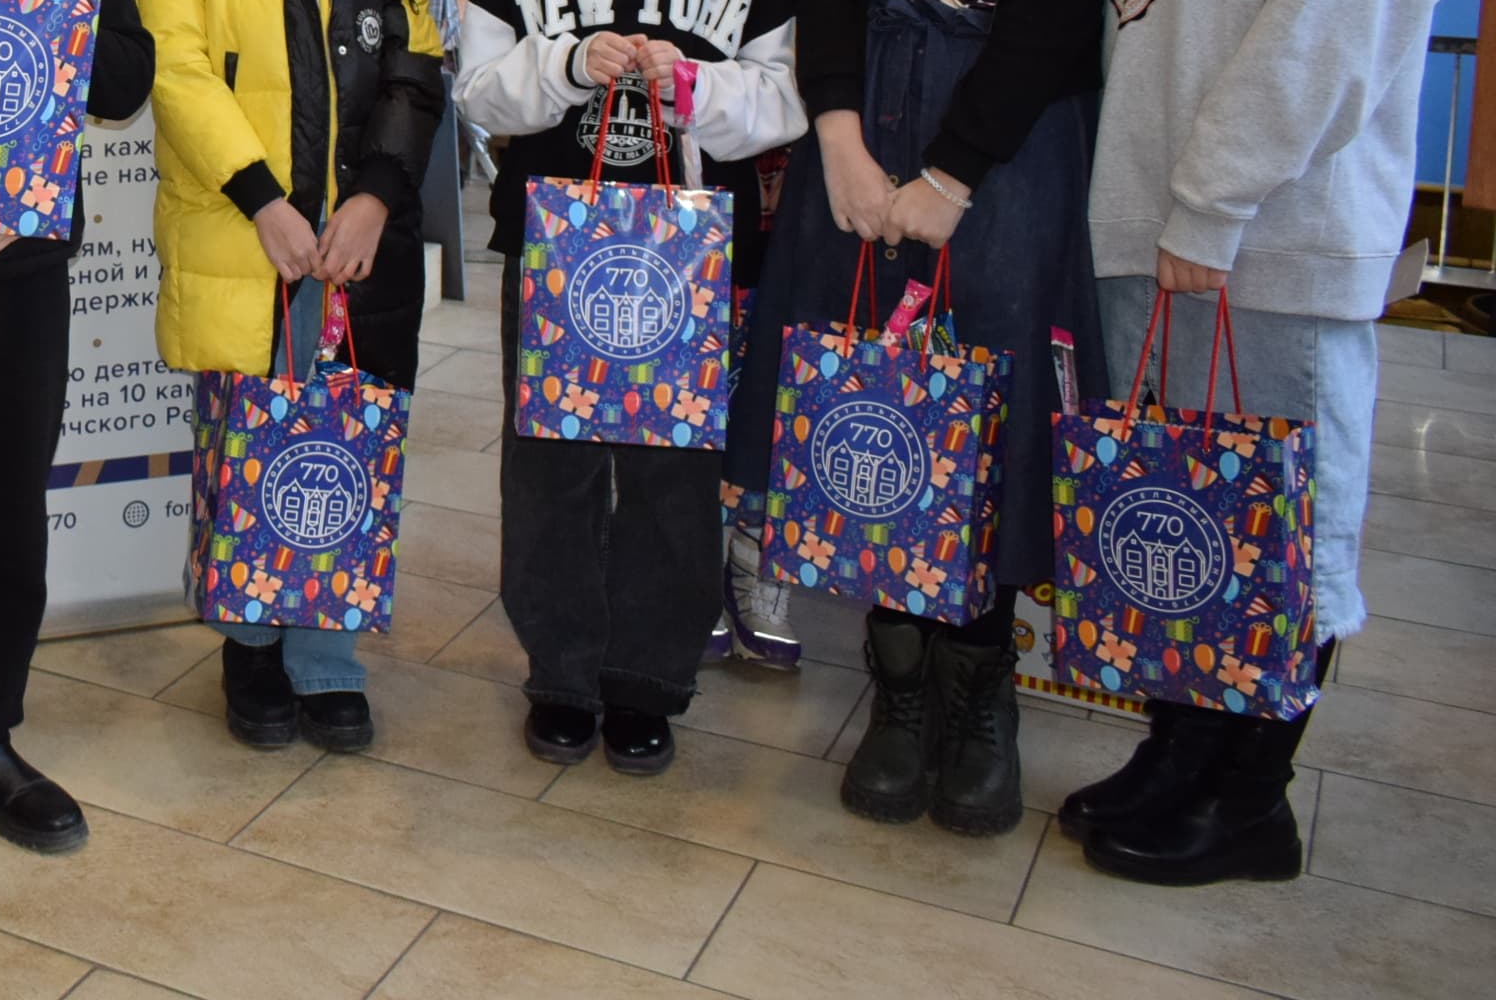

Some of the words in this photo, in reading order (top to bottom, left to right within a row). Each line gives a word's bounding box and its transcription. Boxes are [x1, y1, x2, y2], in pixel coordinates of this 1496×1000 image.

[606, 267, 648, 288] 770
[72, 291, 159, 315] держк
[95, 359, 173, 383] деяте
[81, 391, 110, 408] на
[120, 383, 146, 404] 10
[850, 422, 893, 448] 770
[300, 462, 339, 482] 770
[47, 511, 77, 531] 70
[1136, 511, 1184, 536] 770
